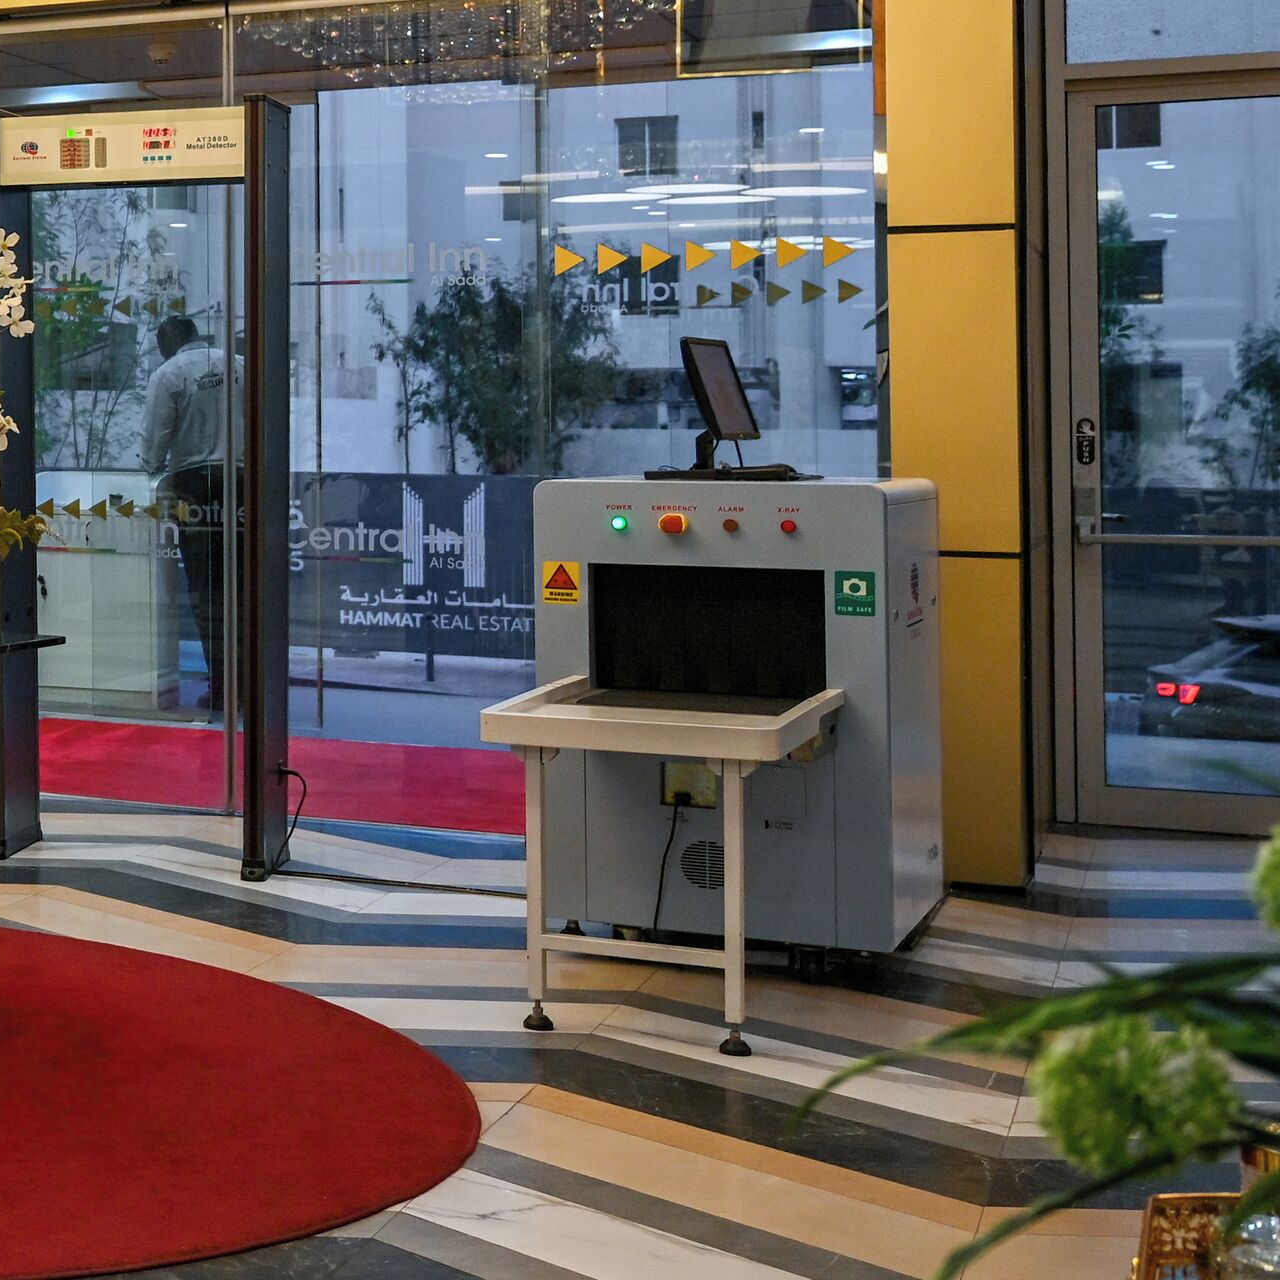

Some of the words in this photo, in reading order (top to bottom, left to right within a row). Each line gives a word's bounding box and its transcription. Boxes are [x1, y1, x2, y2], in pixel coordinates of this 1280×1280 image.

[429, 242, 486, 273] Inn
[431, 274, 443, 286] Al
[448, 274, 486, 286] Sadd
[288, 522, 414, 553] Centra
[429, 557, 443, 569] Al
[340, 585, 438, 607] العقارية
[340, 609, 423, 628] HAMMAT
[431, 613, 474, 630] REAL
[479, 616, 535, 632] ESTAT
